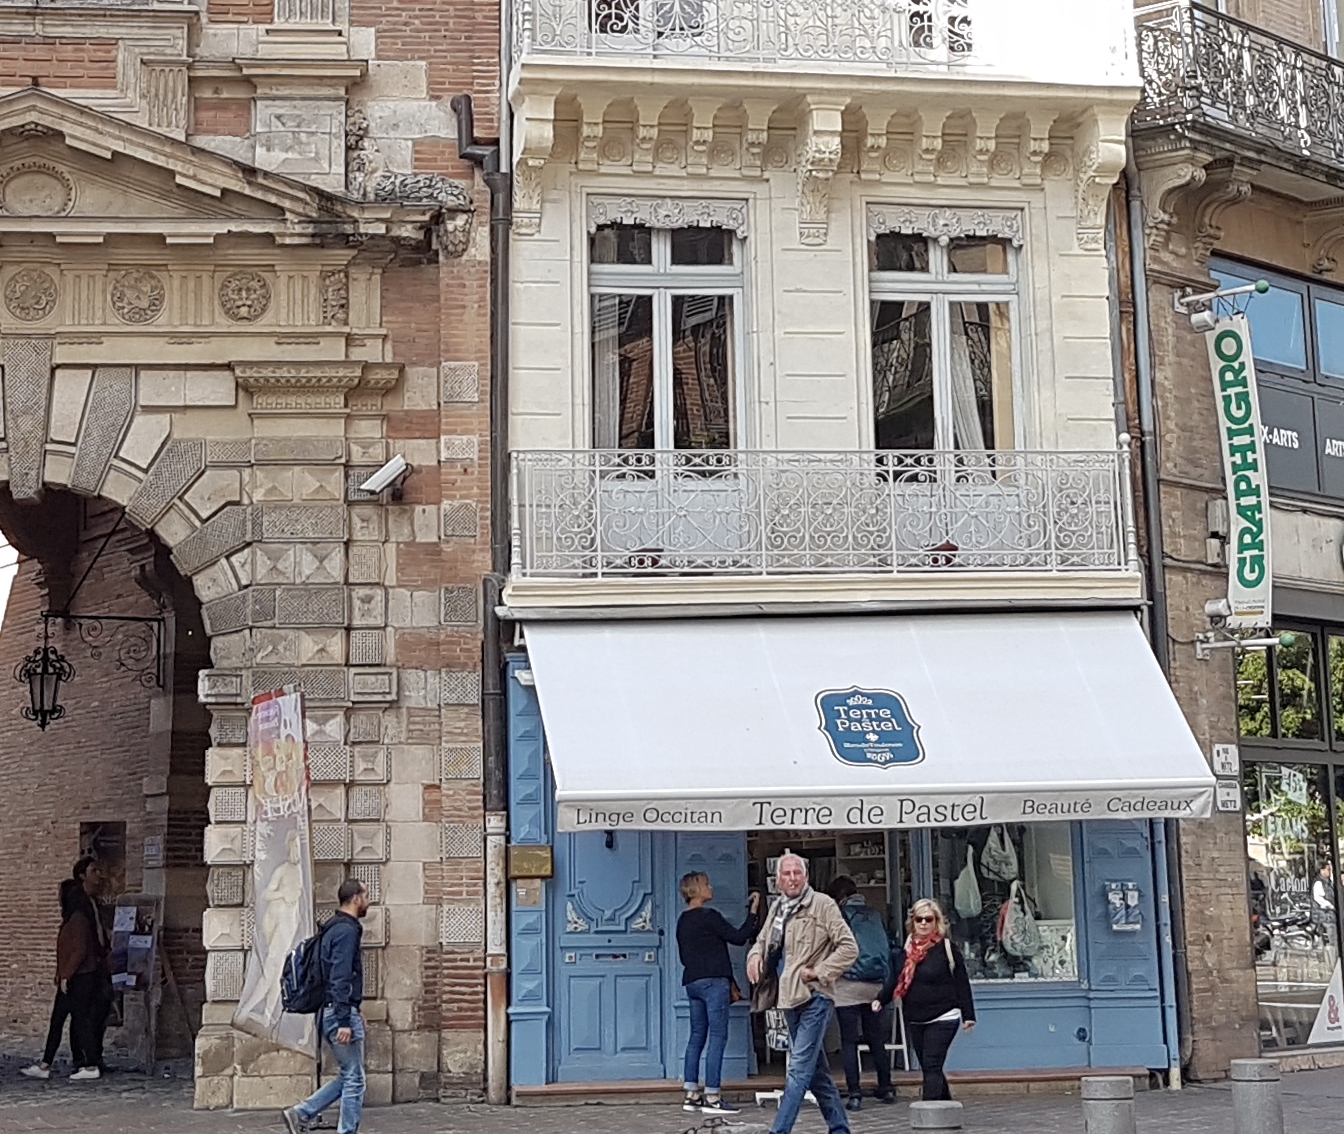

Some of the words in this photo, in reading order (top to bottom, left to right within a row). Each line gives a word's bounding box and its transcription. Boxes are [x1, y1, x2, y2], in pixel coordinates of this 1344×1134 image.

[1214, 328, 1266, 589] GRAPHIGRO
[834, 706, 891, 719] Terre
[835, 718, 902, 731] Pastel
[575, 807, 634, 827] Linge
[643, 807, 723, 825] Occitan
[752, 801, 833, 826] Terre
[846, 799, 885, 826] de
[896, 796, 988, 824] Pastel
[1021, 798, 1092, 815] Beauté
[1106, 796, 1194, 813] Cadeaux
